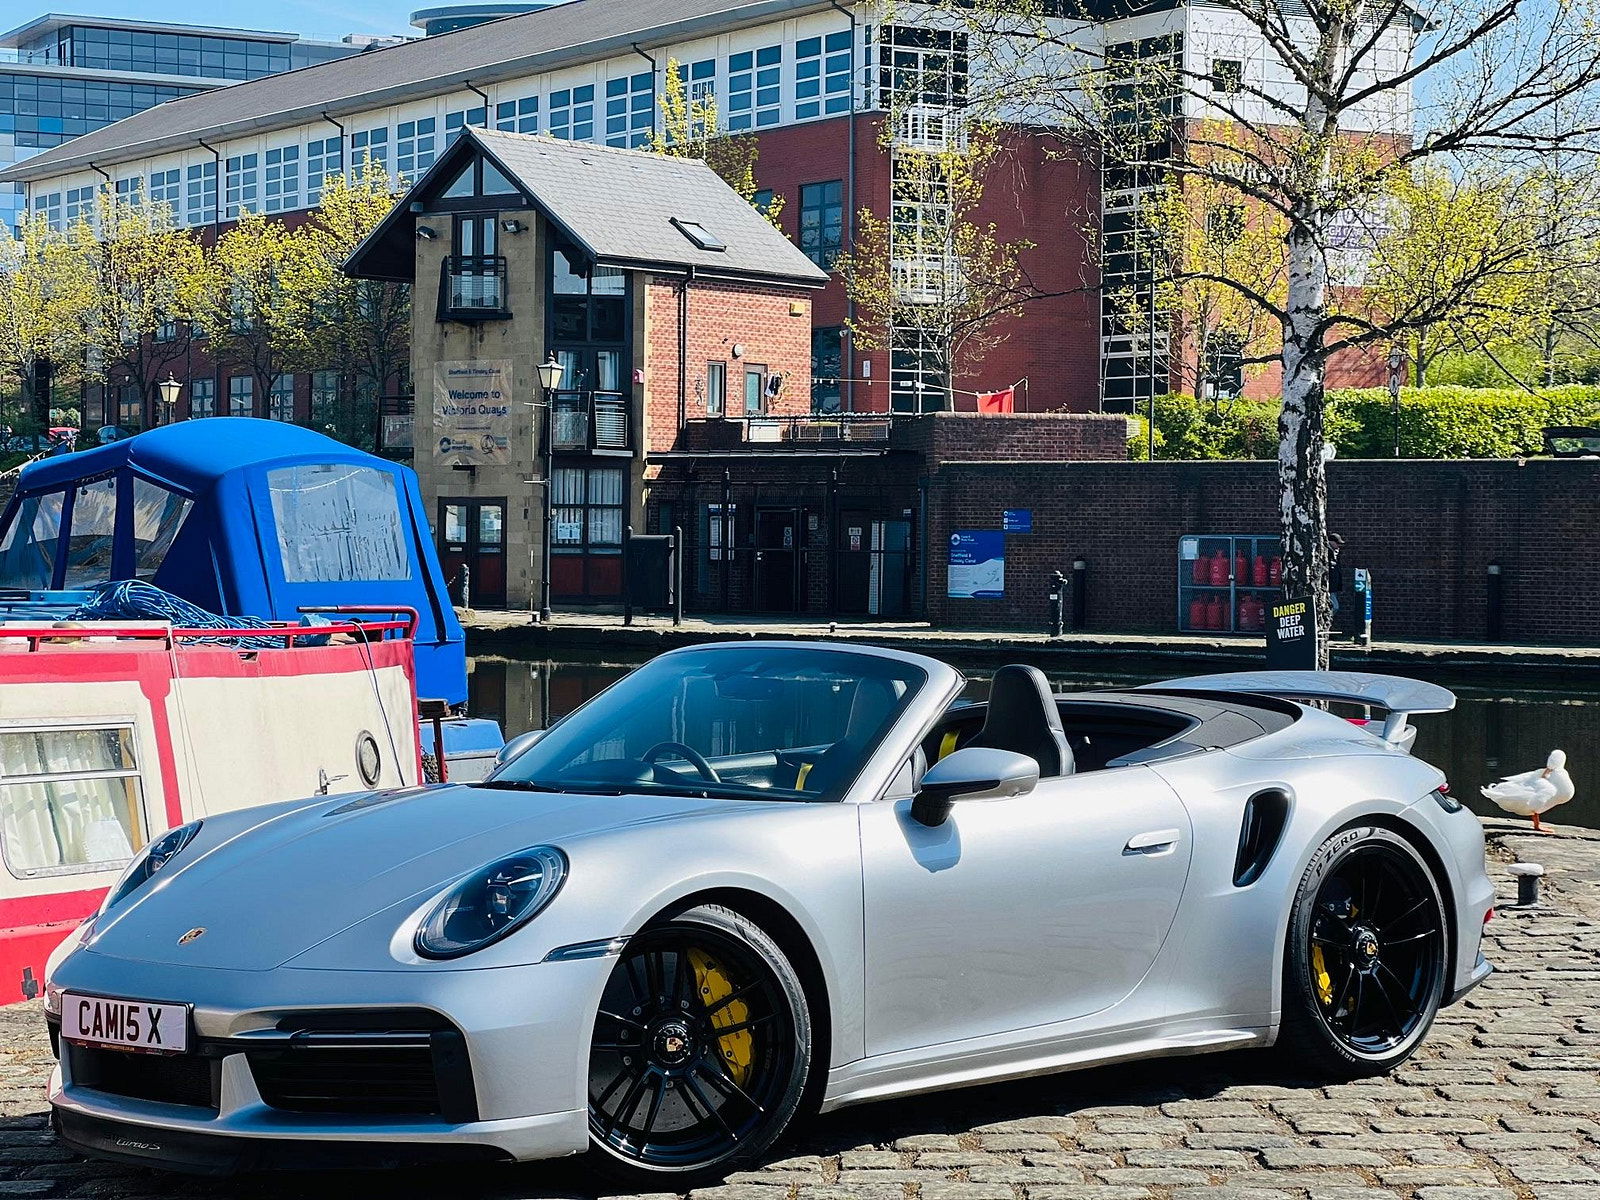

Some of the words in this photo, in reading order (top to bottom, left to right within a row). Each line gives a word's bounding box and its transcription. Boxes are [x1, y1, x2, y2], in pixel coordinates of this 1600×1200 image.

[448, 390, 489, 399] Welcome
[491, 391, 501, 399] to
[442, 405, 476, 415] Victoria
[478, 405, 507, 416] Quays
[1273, 602, 1306, 618] DANGER
[1279, 614, 1301, 628] DEEP
[1276, 625, 1305, 640] WATER
[1316, 862, 1322, 877] P
[1324, 831, 1359, 863] ZERO
[147, 1007, 162, 1044] X
